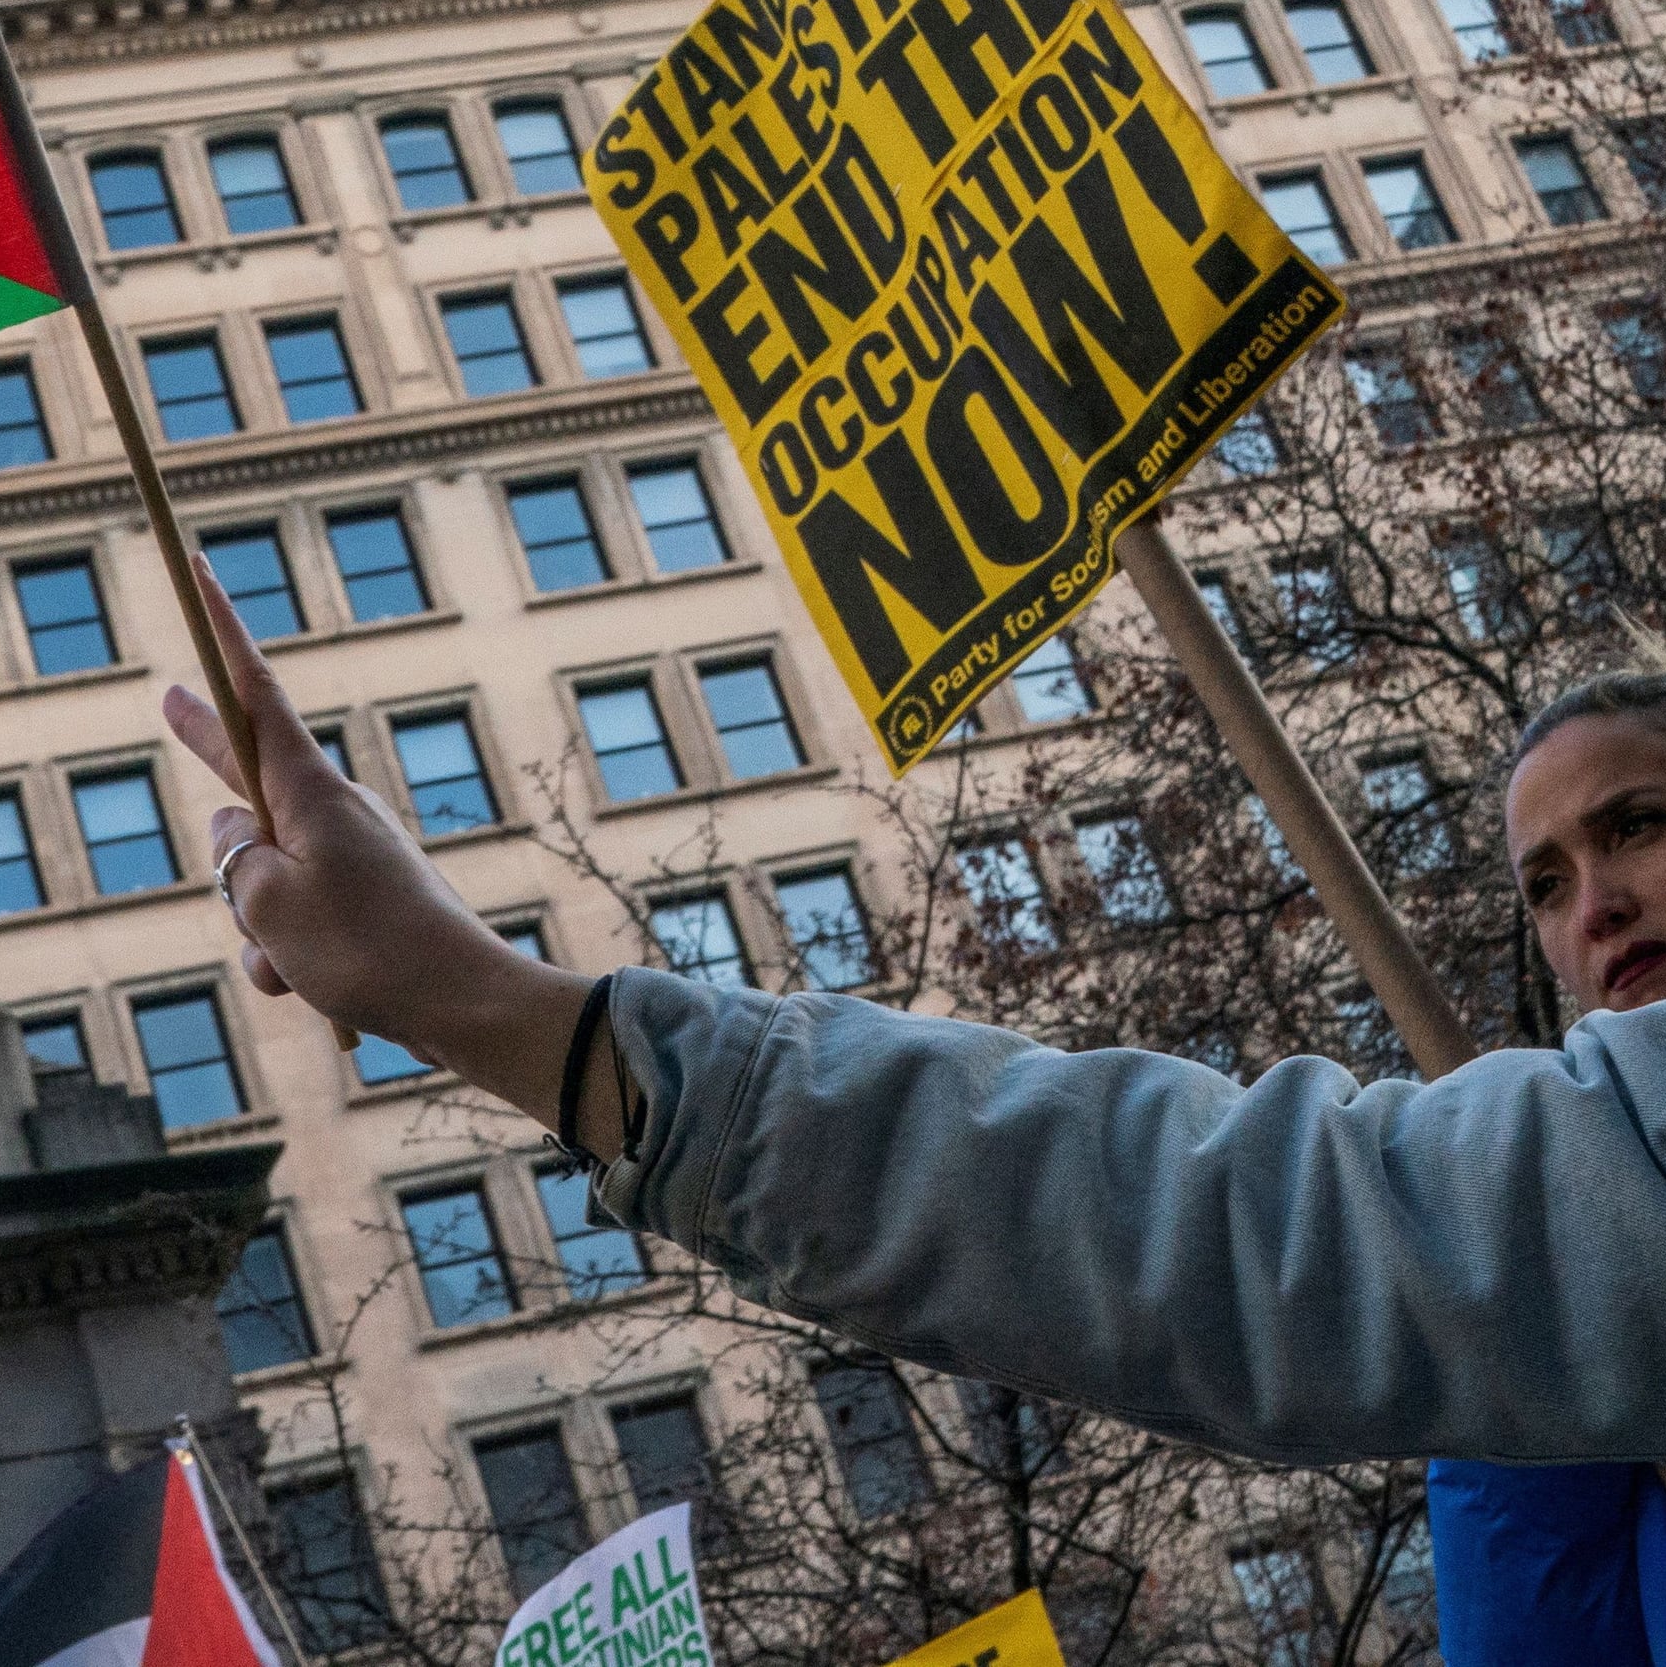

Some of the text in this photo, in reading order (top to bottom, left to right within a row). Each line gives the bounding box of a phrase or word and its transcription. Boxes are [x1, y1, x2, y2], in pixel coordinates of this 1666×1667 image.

[688, 122, 906, 430] END
[759, 7, 1143, 517] OCCUPATION
[796, 100, 1261, 701] NOW!
[930, 284, 1324, 706] Party for Socism and Liberation
[612, 1536, 688, 1627] ALL
